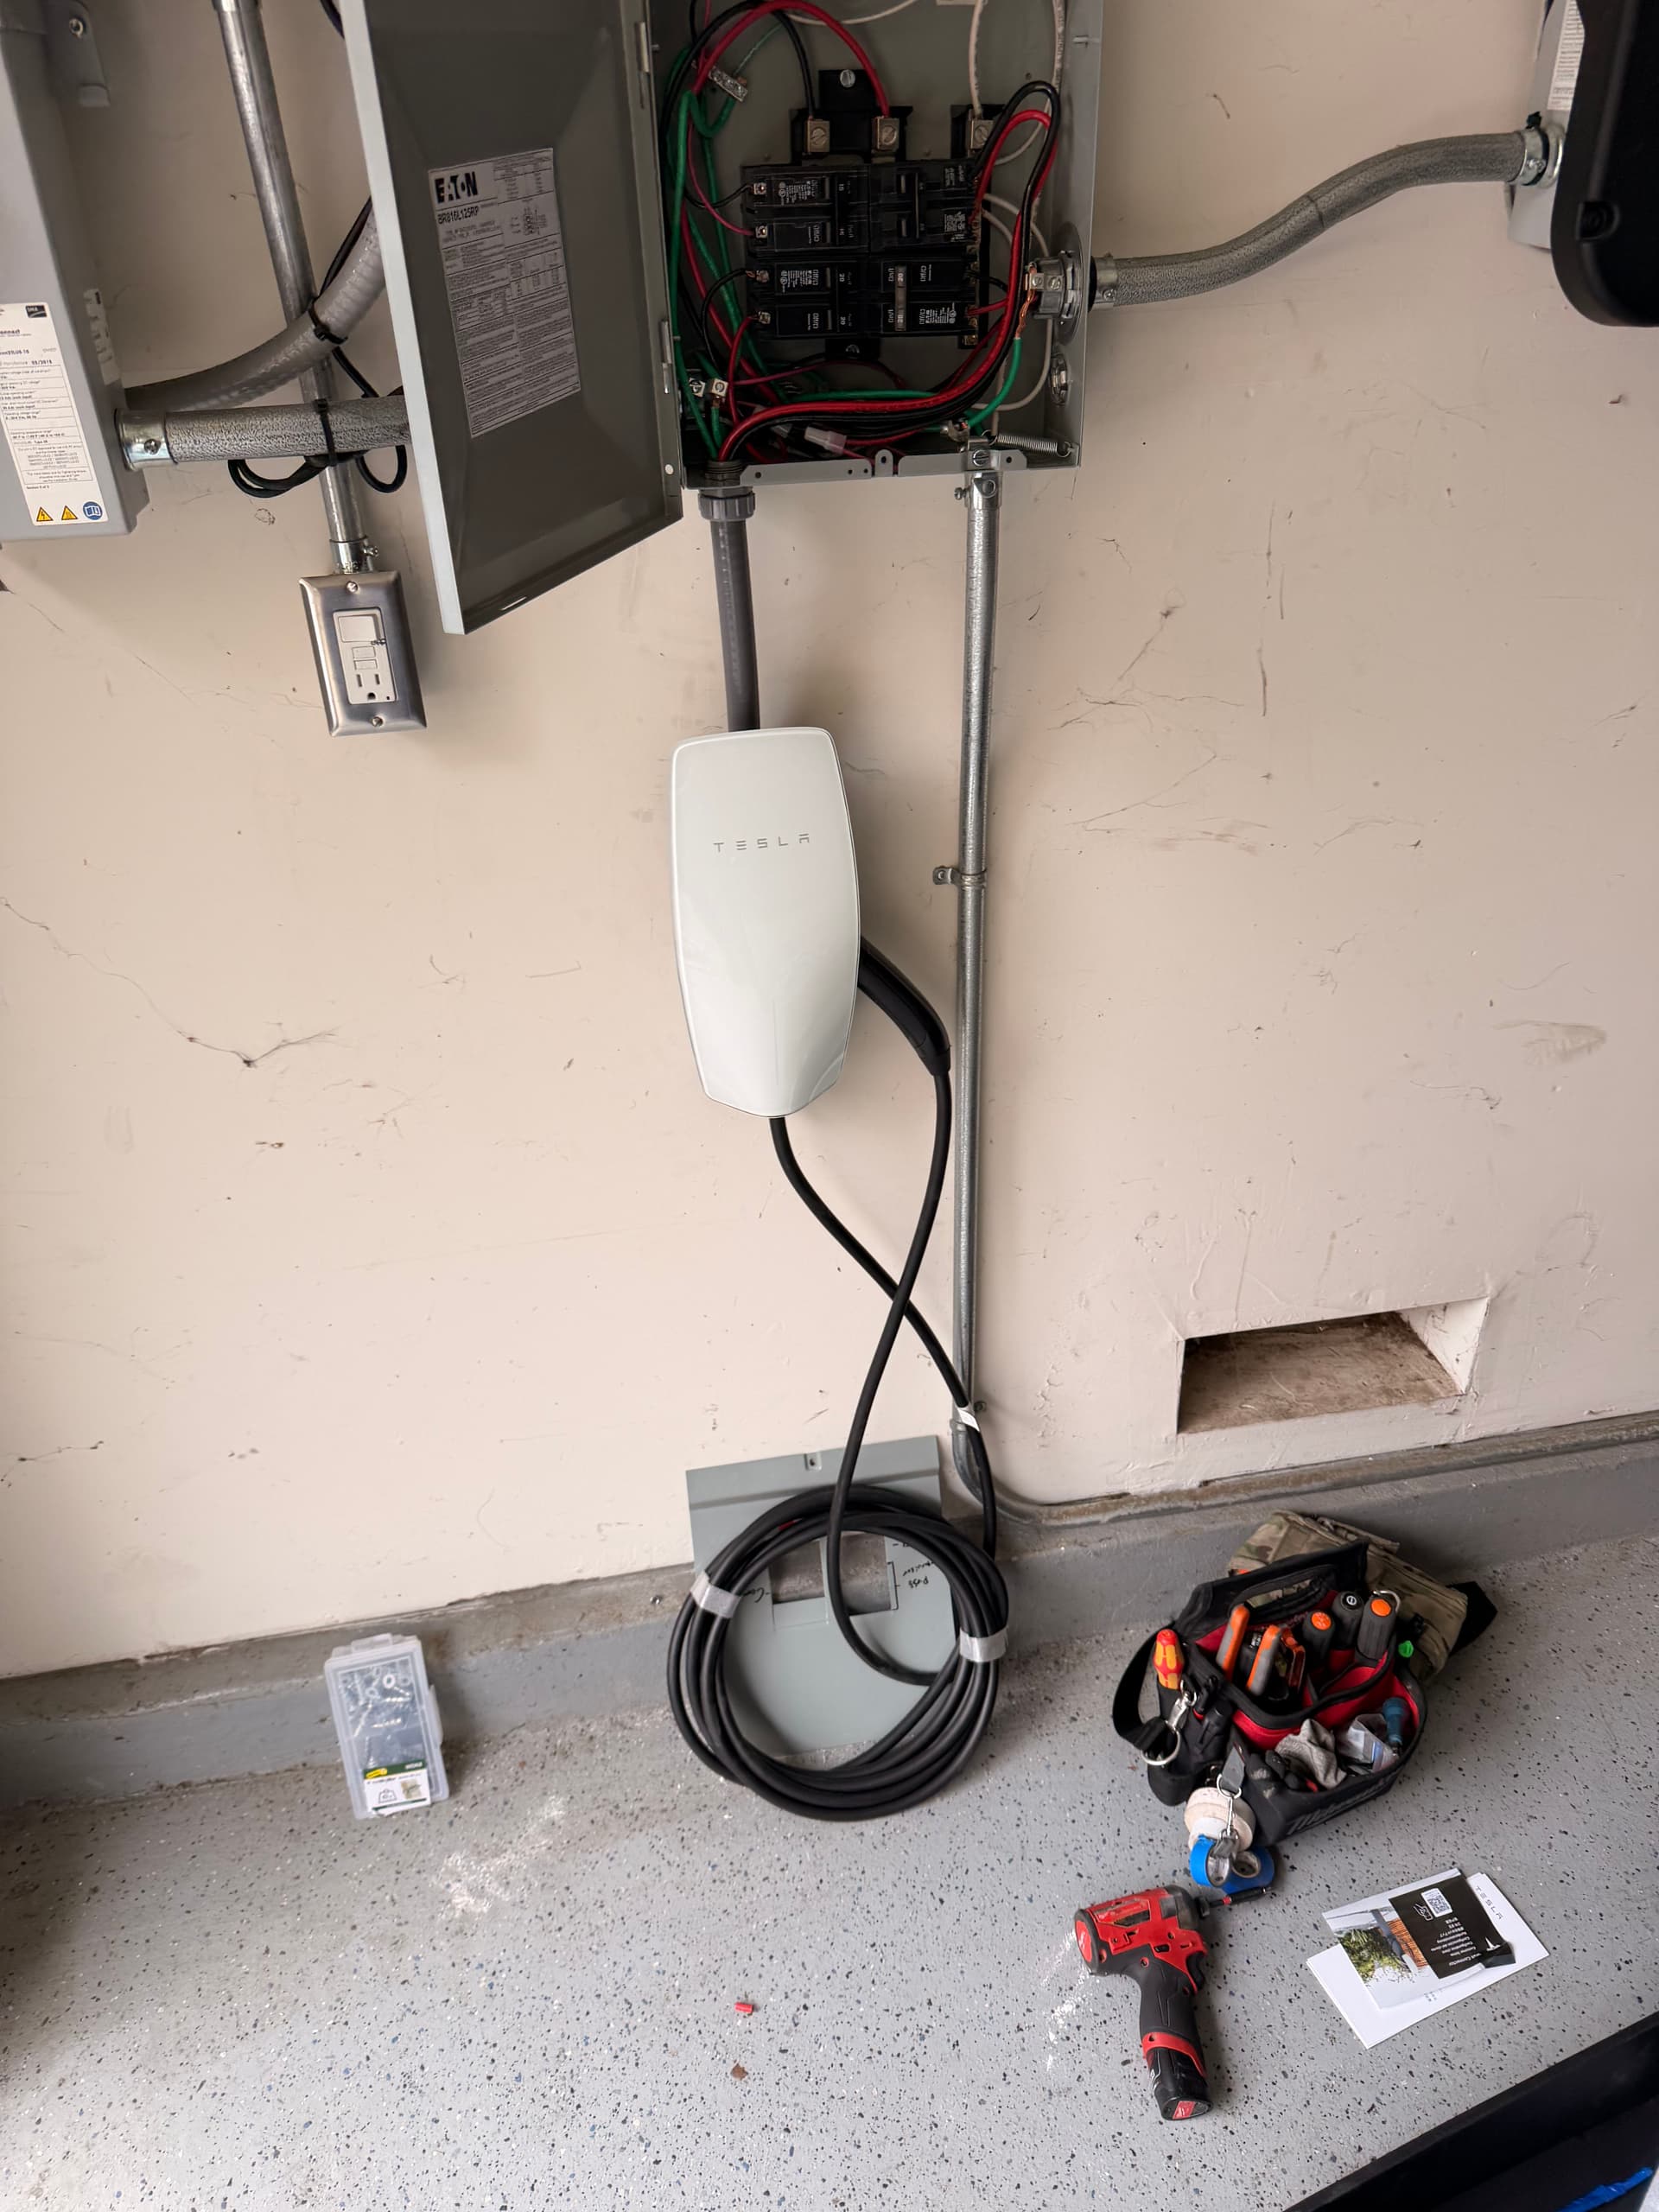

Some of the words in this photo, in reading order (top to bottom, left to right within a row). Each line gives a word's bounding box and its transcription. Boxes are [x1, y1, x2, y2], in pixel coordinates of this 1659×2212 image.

[434, 171, 479, 204] EATON
[839, 273, 846, 283] 20
[840, 316, 846, 326] 20
[713, 833, 810, 853] TESLA
[1476, 1885, 1503, 1919] TESLA
